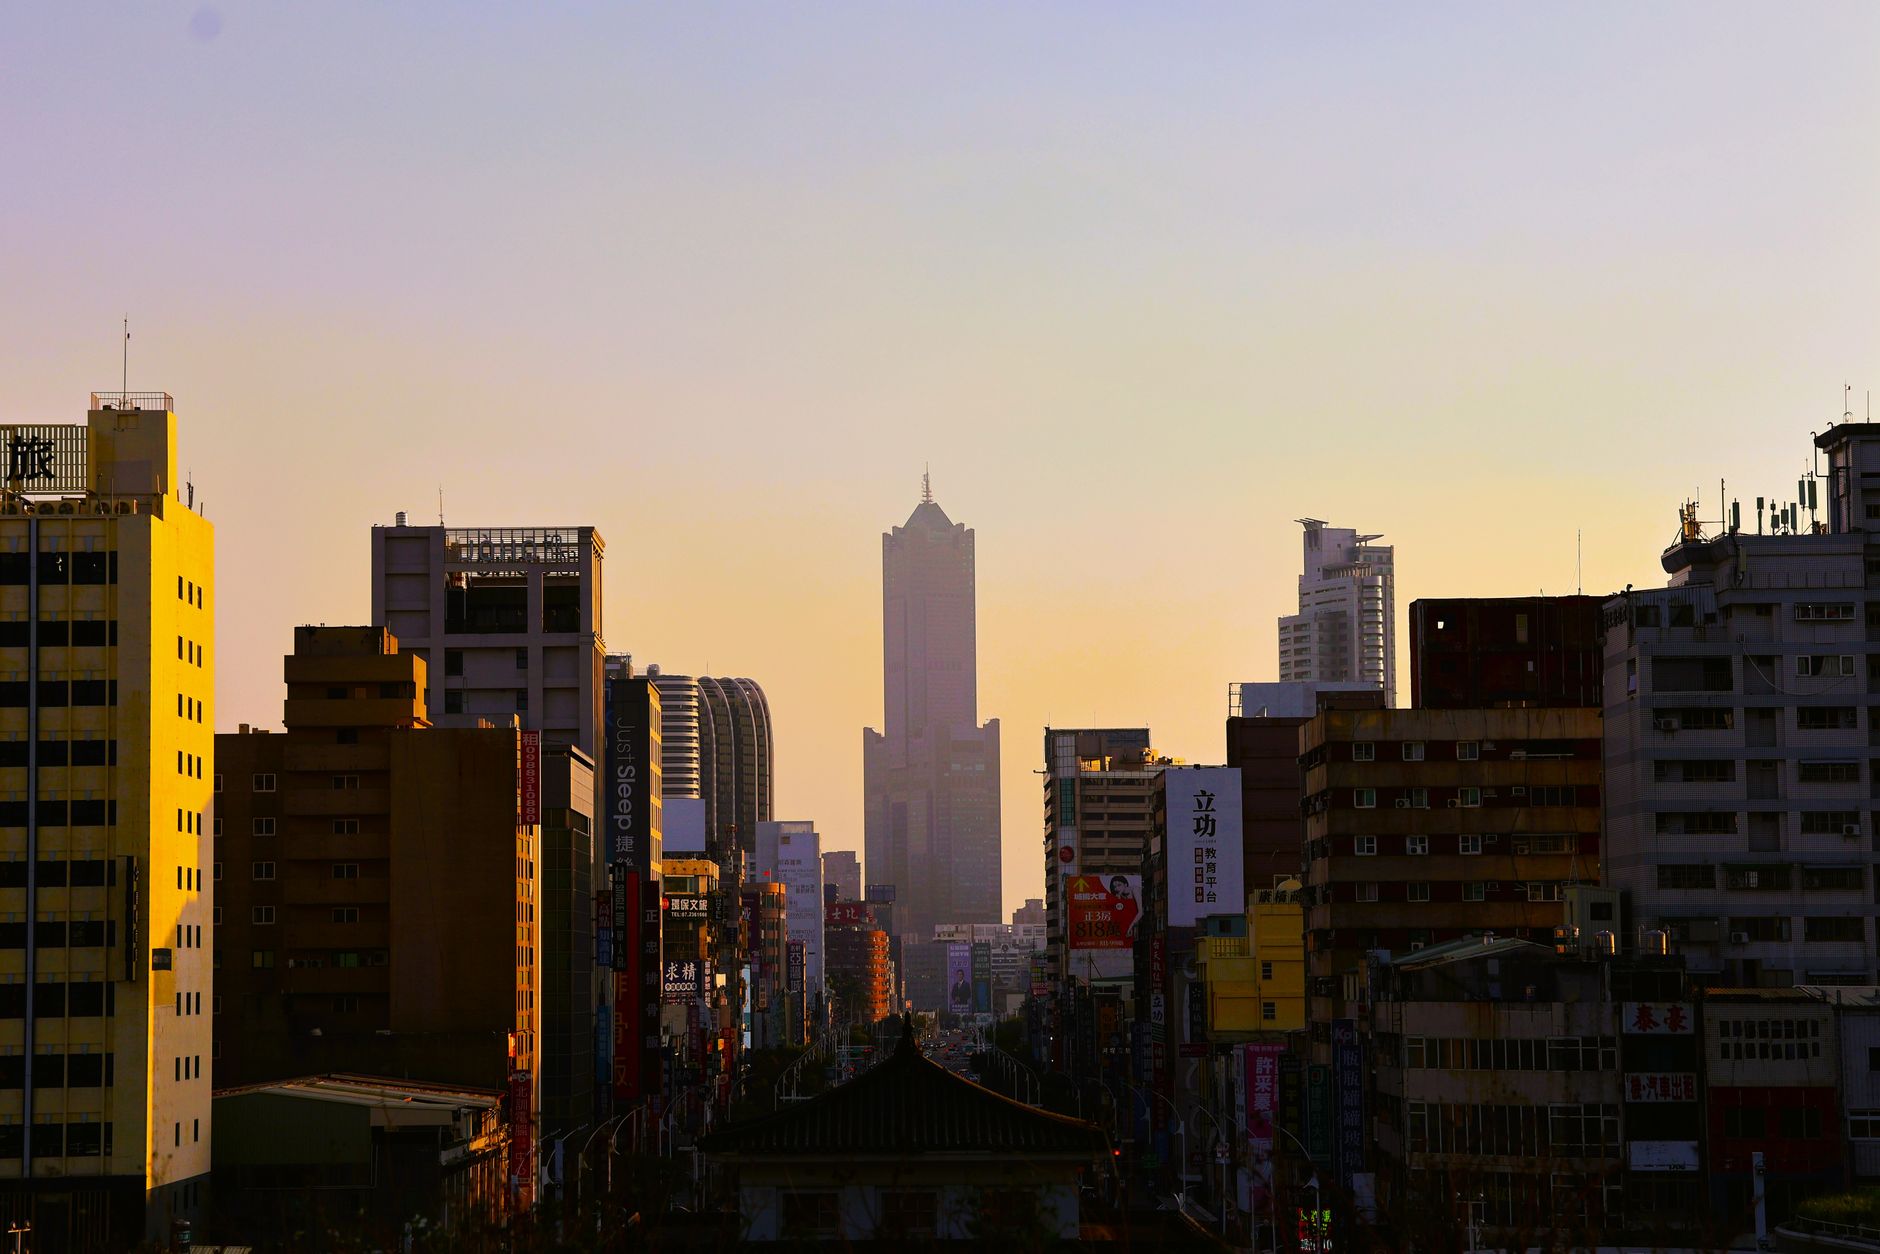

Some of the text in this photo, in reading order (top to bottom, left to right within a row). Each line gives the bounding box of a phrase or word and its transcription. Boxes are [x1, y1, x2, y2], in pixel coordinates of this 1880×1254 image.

[6, 435, 55, 480] 旅
[1193, 790, 1216, 838] 立功
[1204, 847, 1217, 903] 教育平台
[665, 962, 697, 981] 求精
